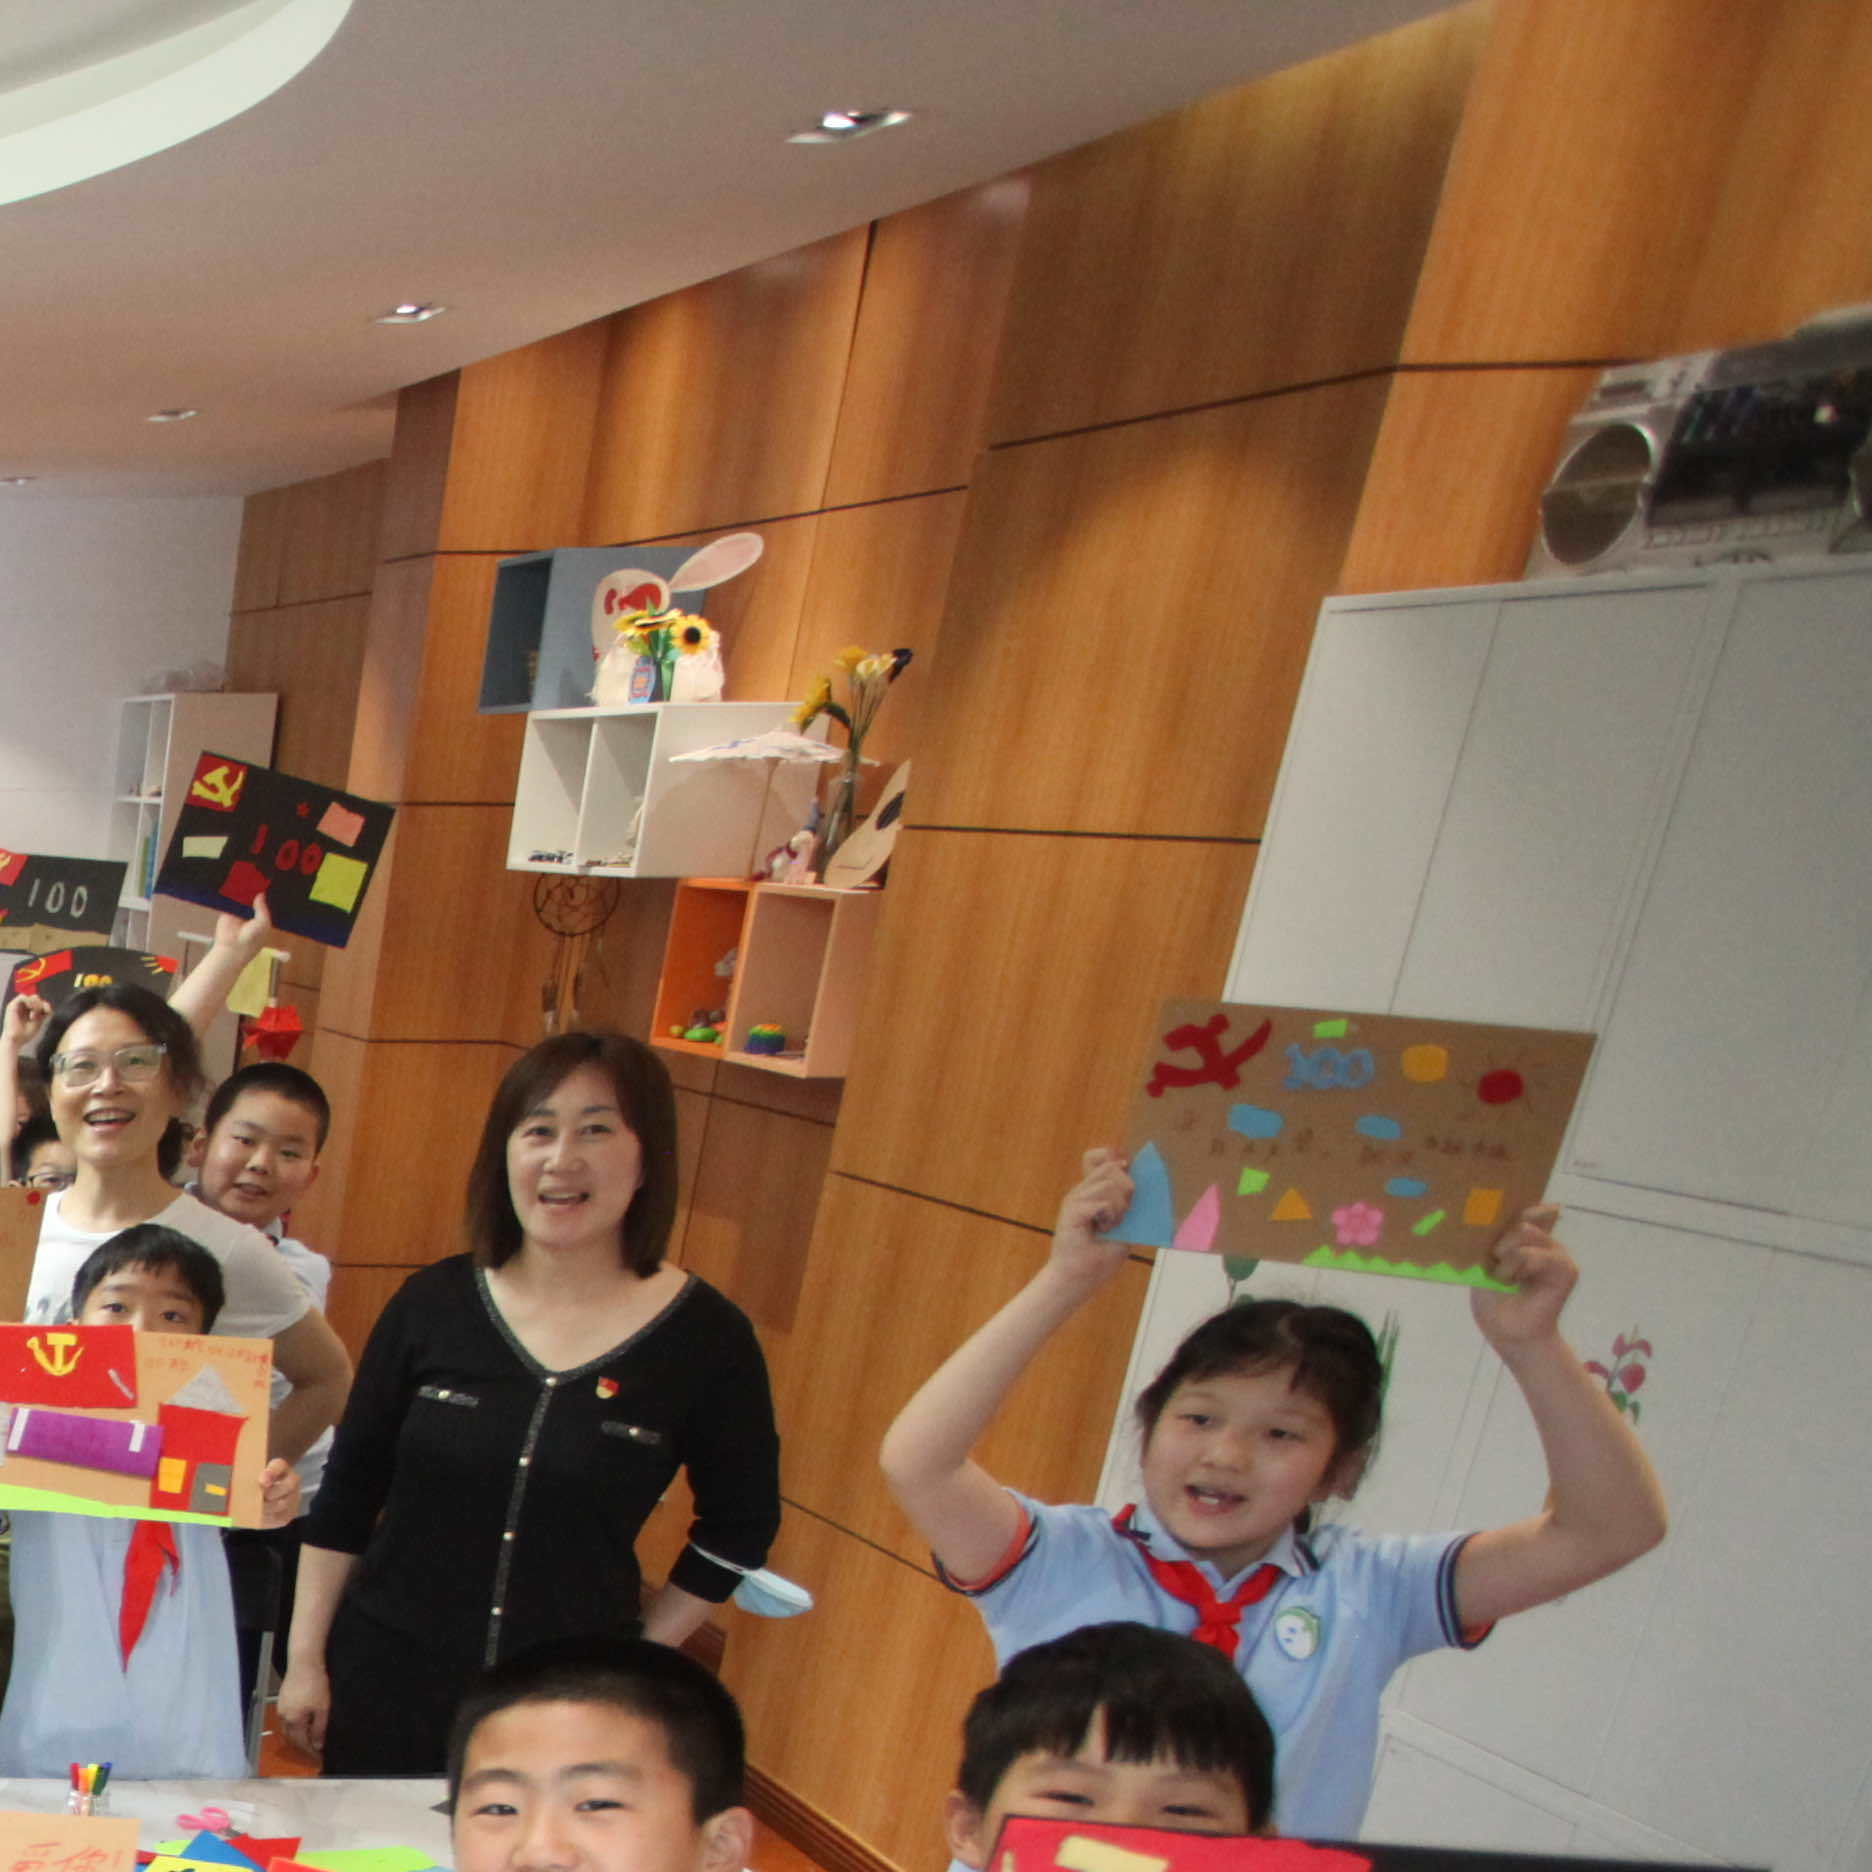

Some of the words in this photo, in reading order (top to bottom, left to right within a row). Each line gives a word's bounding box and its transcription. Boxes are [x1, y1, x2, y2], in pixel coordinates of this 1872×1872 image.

[251, 824, 323, 875] 100
[27, 878, 88, 918] 100
[1283, 1043, 1375, 1091] 100
